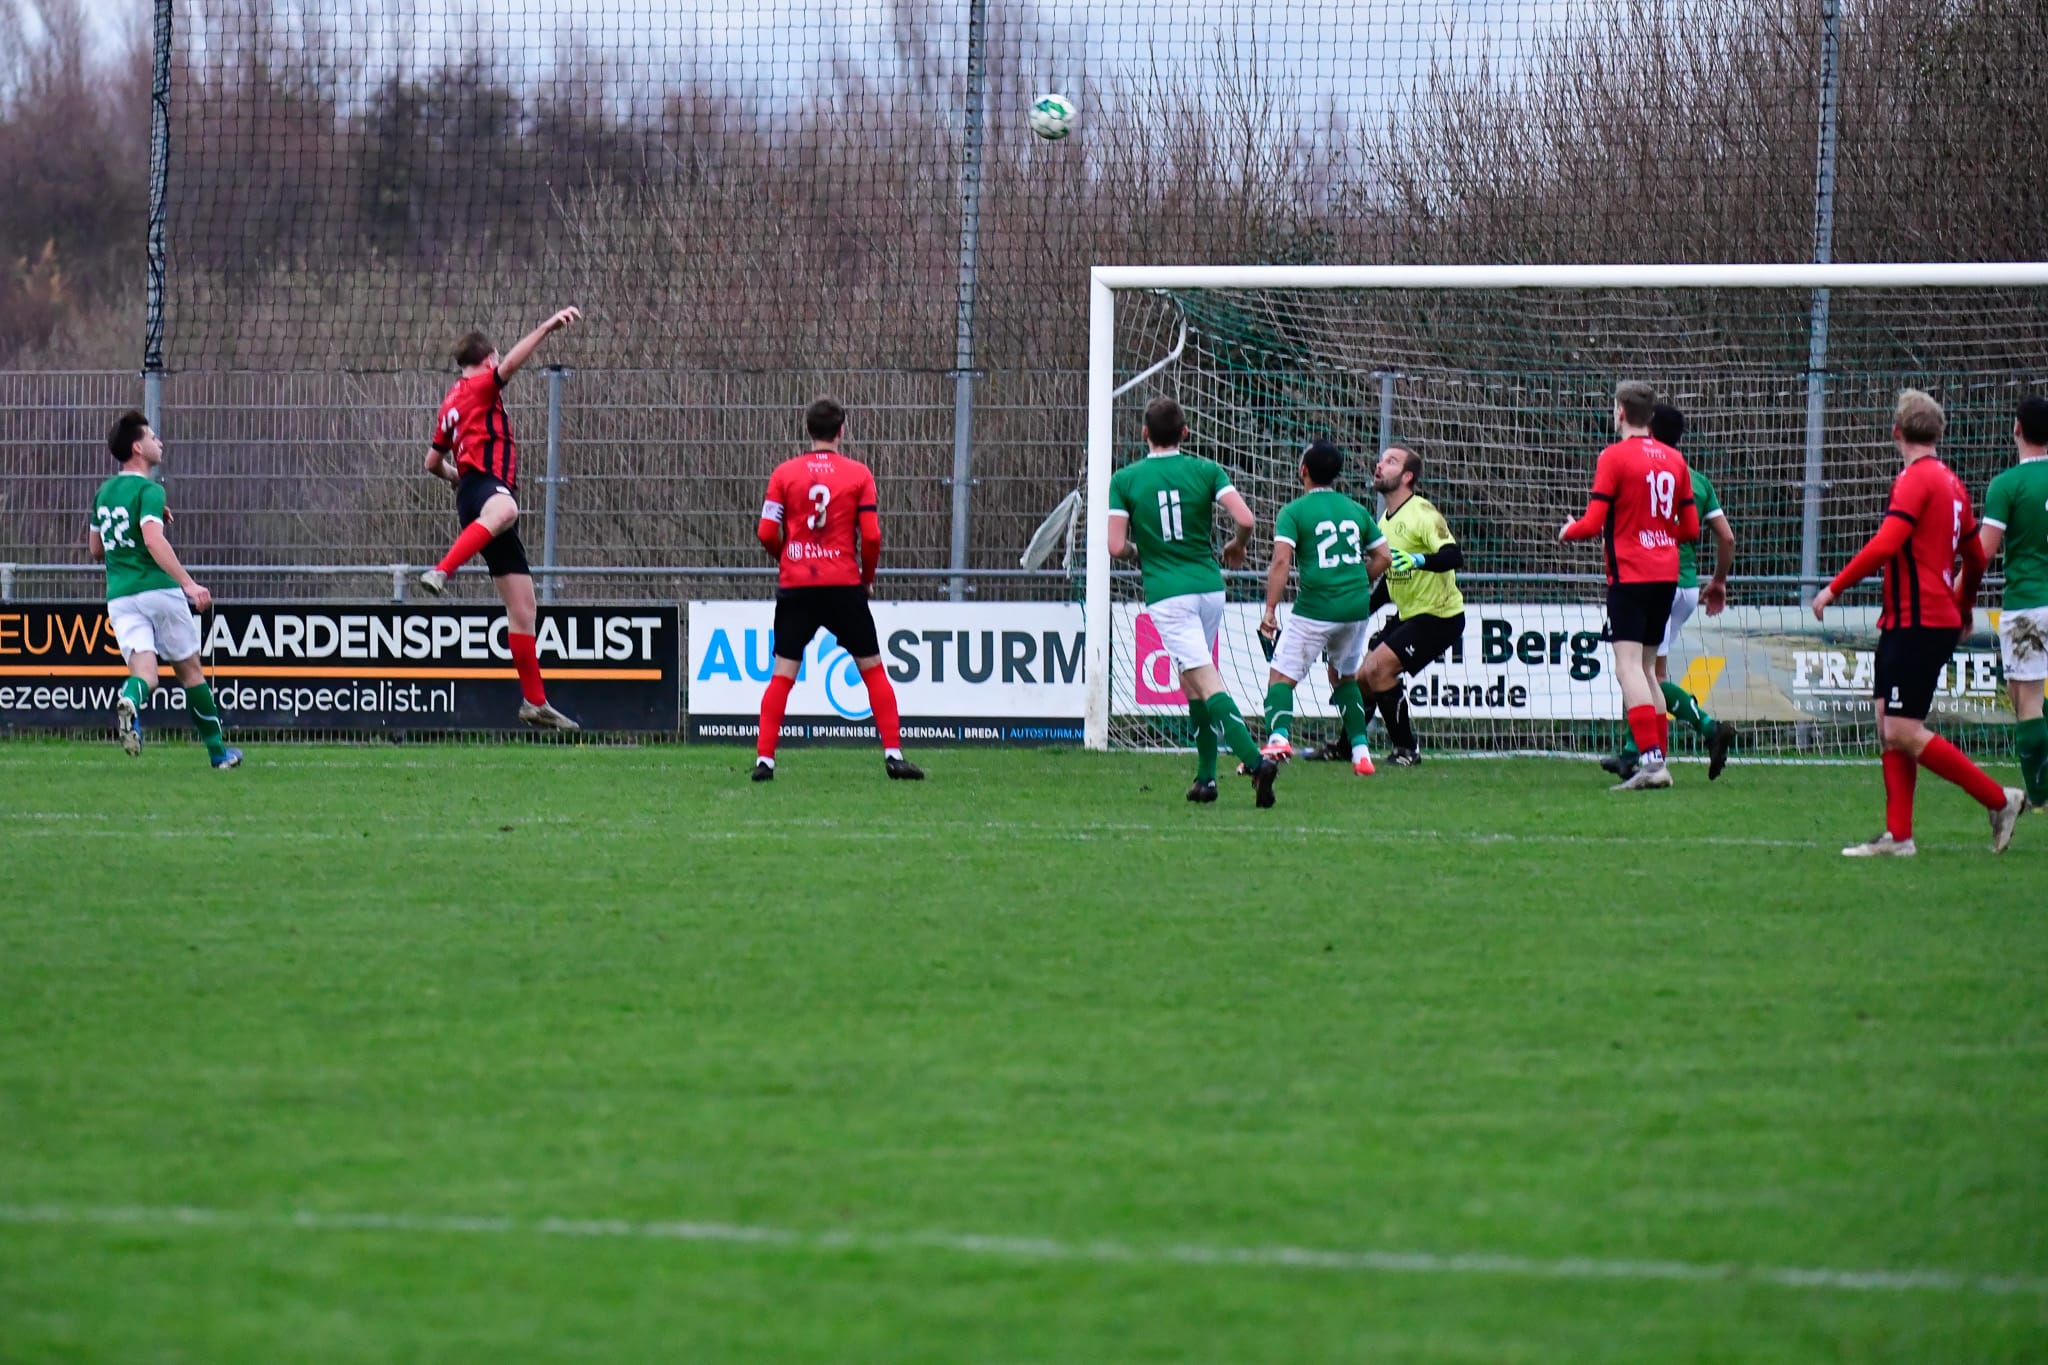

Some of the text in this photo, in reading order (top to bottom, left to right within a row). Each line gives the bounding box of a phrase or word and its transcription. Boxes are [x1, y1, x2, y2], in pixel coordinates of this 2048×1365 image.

[807, 483, 831, 530] 3
[1158, 489, 1183, 541] 11
[1646, 469, 1676, 520] 19
[96, 505, 136, 550] 22
[1315, 519, 1361, 568] 23
[1952, 499, 1963, 551] 5
[0, 613, 662, 660] EUWS AARDENSPECALIST
[887, 629, 1086, 684] STURM
[1482, 619, 1600, 681] Berg
[1792, 651, 1997, 696] FRAJE
[700, 724, 760, 737] MIDDELBUR
[812, 725, 876, 738] SPIJKENISSE
[899, 727, 956, 739] OSENDAAL
[964, 728, 999, 739] BREDA
